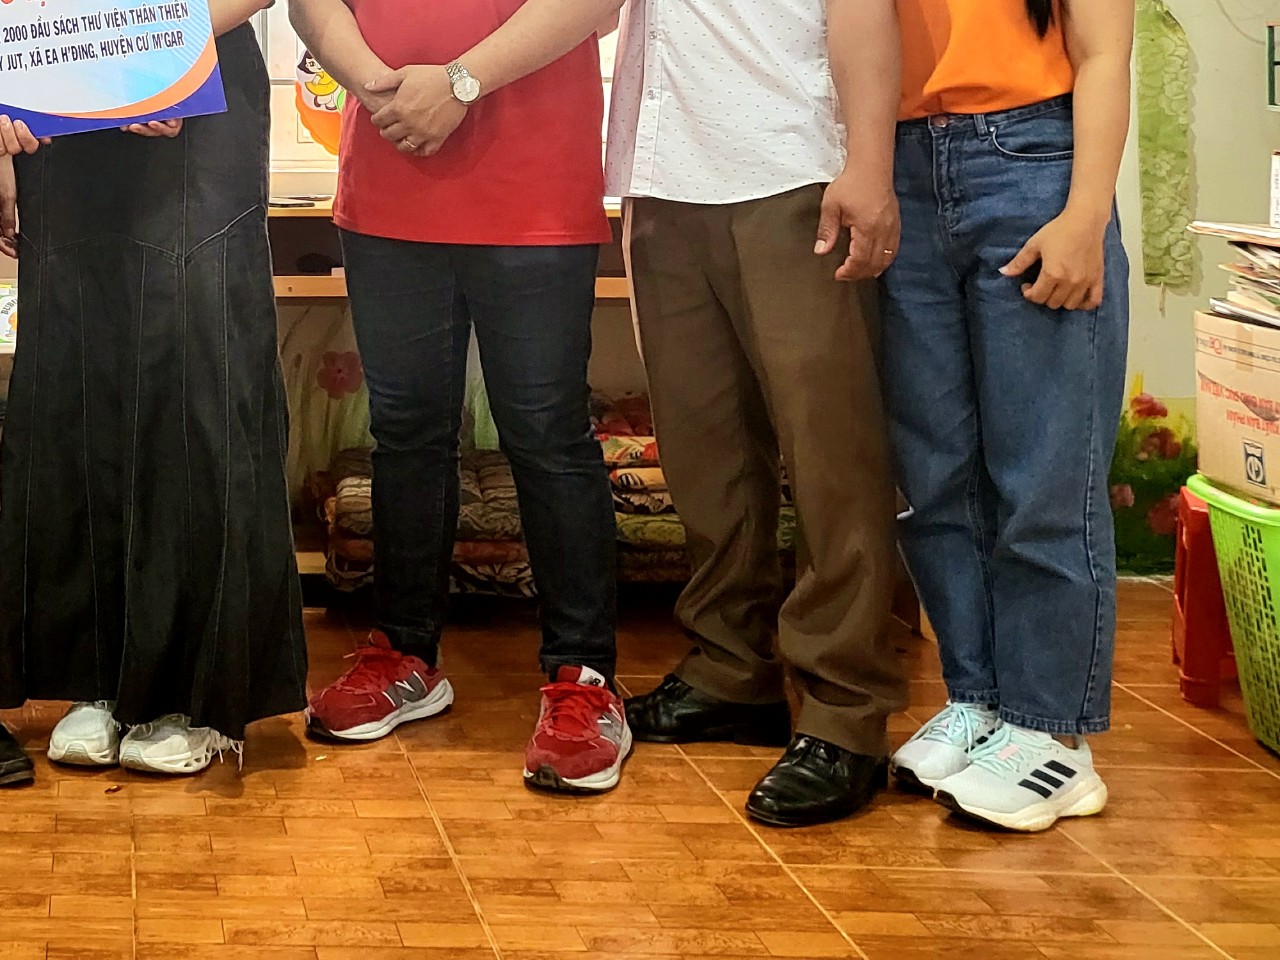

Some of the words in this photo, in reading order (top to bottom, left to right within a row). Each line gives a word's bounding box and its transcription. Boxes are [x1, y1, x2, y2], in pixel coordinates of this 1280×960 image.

[3, 23, 28, 43] 2000
[30, 15, 51, 40] ĐẦU
[53, 14, 80, 36] SÁCH
[81, 10, 102, 32] THƯ
[104, 7, 128, 32] VIỆN
[129, 4, 157, 25] THÂN
[7, 53, 28, 71] JUT,
[29, 46, 43, 68] XÃ
[45, 48, 59, 65] EA
[100, 35, 134, 59] HUYỆN
[135, 31, 150, 52] CƯ
[151, 30, 185, 50] M'GAR
